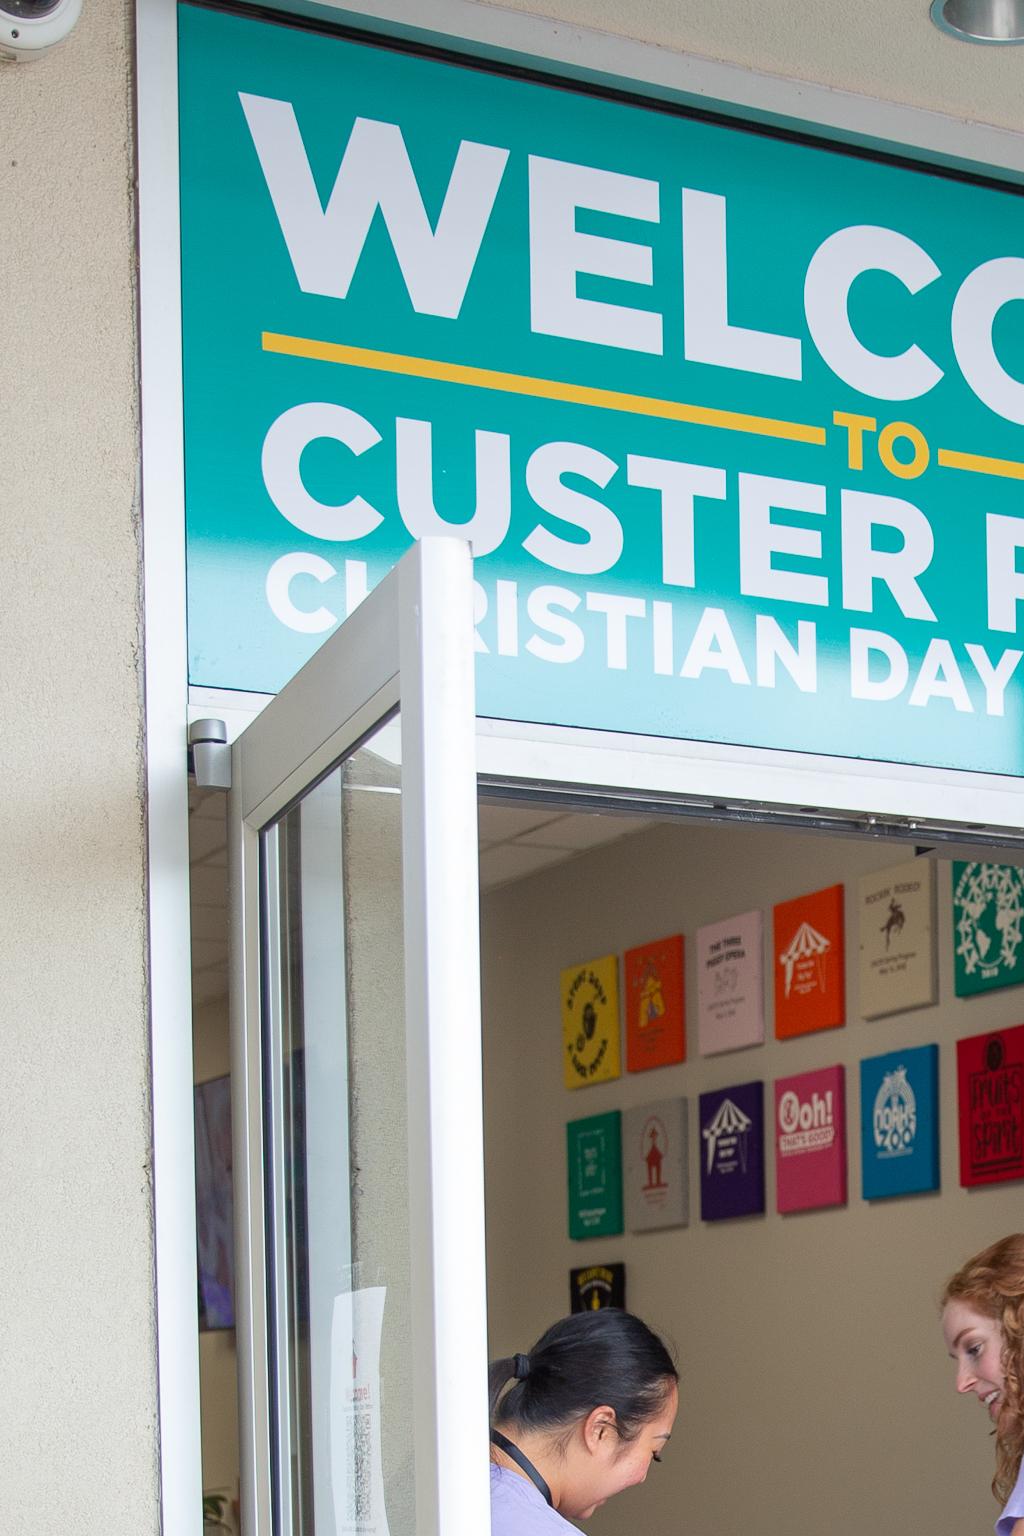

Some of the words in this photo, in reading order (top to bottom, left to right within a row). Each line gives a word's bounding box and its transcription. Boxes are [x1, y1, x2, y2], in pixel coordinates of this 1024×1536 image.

[833, 410, 930, 480] TO
[261, 402, 938, 622] CUSTER
[850, 626, 1024, 717] DAY
[779, 1091, 833, 1134] Ooh!
[880, 1128, 913, 1149] ZOO
